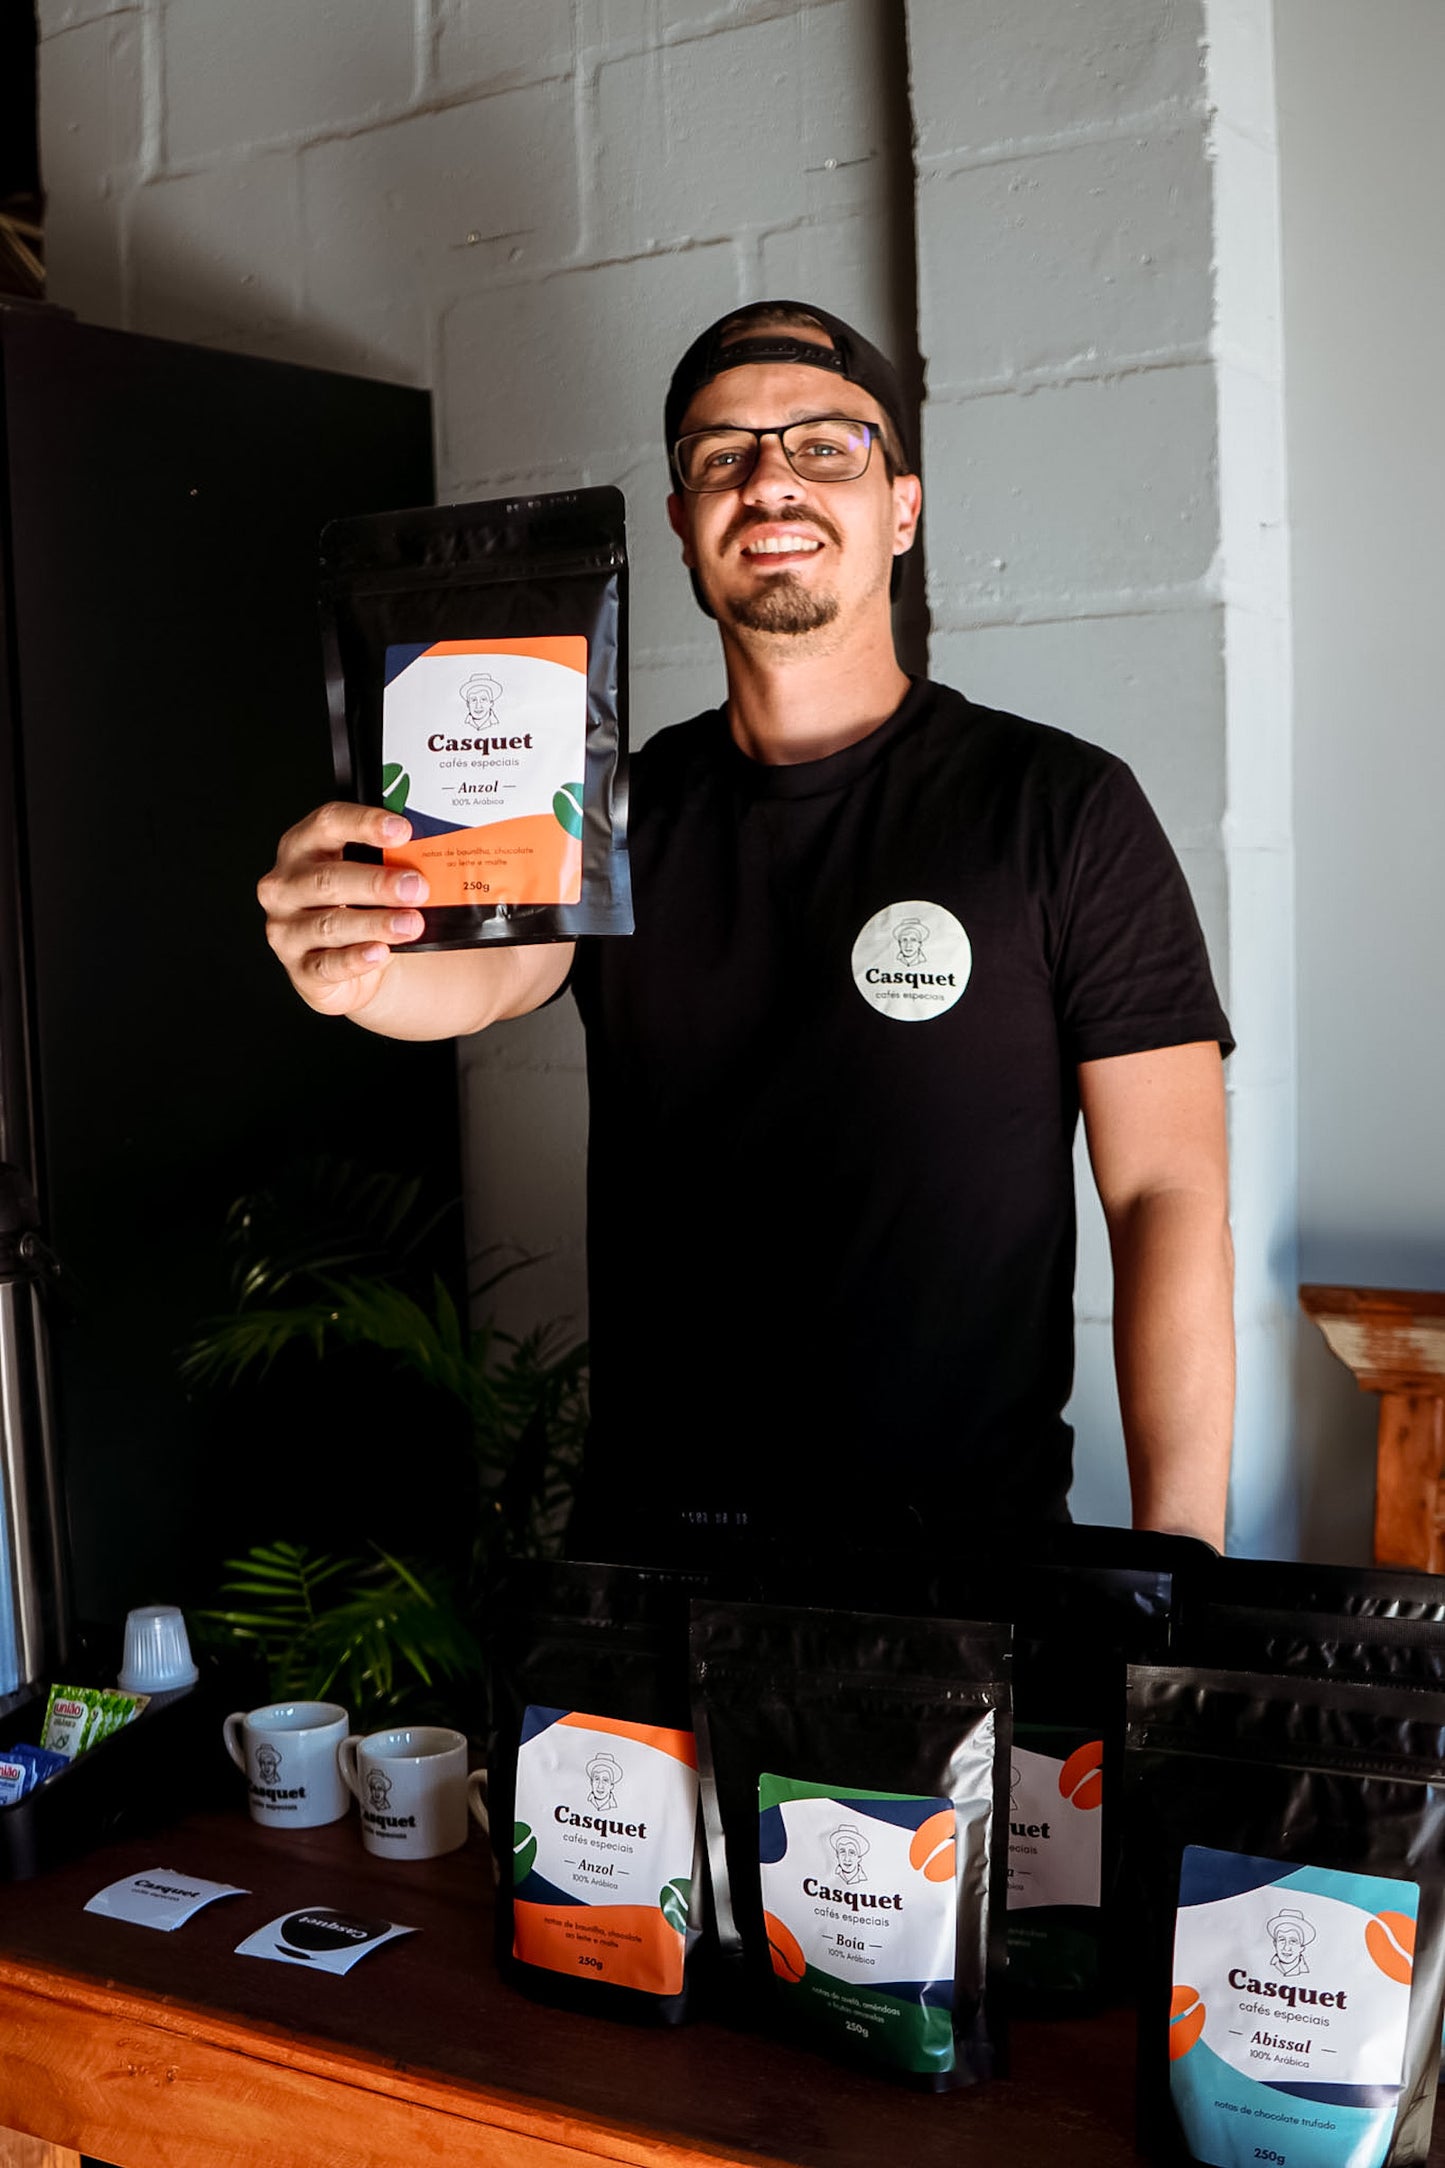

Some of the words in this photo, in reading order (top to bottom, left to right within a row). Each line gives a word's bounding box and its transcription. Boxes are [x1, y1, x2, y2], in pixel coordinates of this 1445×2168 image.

[427, 733, 533, 756] Casquet
[439, 758, 468, 768] cafés
[471, 757, 520, 769] especiais
[457, 780, 499, 794] Anzol
[452, 798, 471, 806] 100%
[463, 881, 490, 892] 250g
[865, 968, 956, 989] Casquet
[875, 989, 900, 999] cafés
[903, 991, 945, 1001] especiais
[0, 1763, 17, 1778] nião
[248, 1784, 306, 1802] asquet
[363, 1810, 416, 1829] asquet
[554, 1805, 647, 1839] Casquet
[563, 1833, 588, 1845] cafés
[590, 1839, 634, 1854] especiais
[1008, 1845, 1038, 1855] eciais
[577, 1859, 614, 1876] Anzol
[572, 1873, 589, 1884] 100%
[134, 1879, 201, 1898] Casquet
[803, 1877, 903, 1912] Casquet
[814, 1907, 840, 1920] cafés
[842, 1912, 890, 1927] especiais
[298, 1916, 368, 1939] Casquet
[836, 1933, 865, 1950] Boia
[828, 1948, 845, 1959] 100%
[578, 1956, 603, 1971] 250g
[1228, 1968, 1348, 2010] Casquet
[1238, 2002, 1270, 2016] cafés
[1274, 2009, 1330, 2027] especiais
[845, 2020, 869, 2038] 250g
[1250, 2031, 1312, 2054] Abissal
[1249, 2049, 1271, 2061] 100%
[1274, 2054, 1310, 2068] Arábica
[1214, 2100, 1238, 2112] notas
[1240, 2105, 1252, 2115] de
[1254, 2108, 1299, 2125] chocolate
[1301, 2117, 1336, 2130] trufado
[1254, 2147, 1286, 2166] 250g
